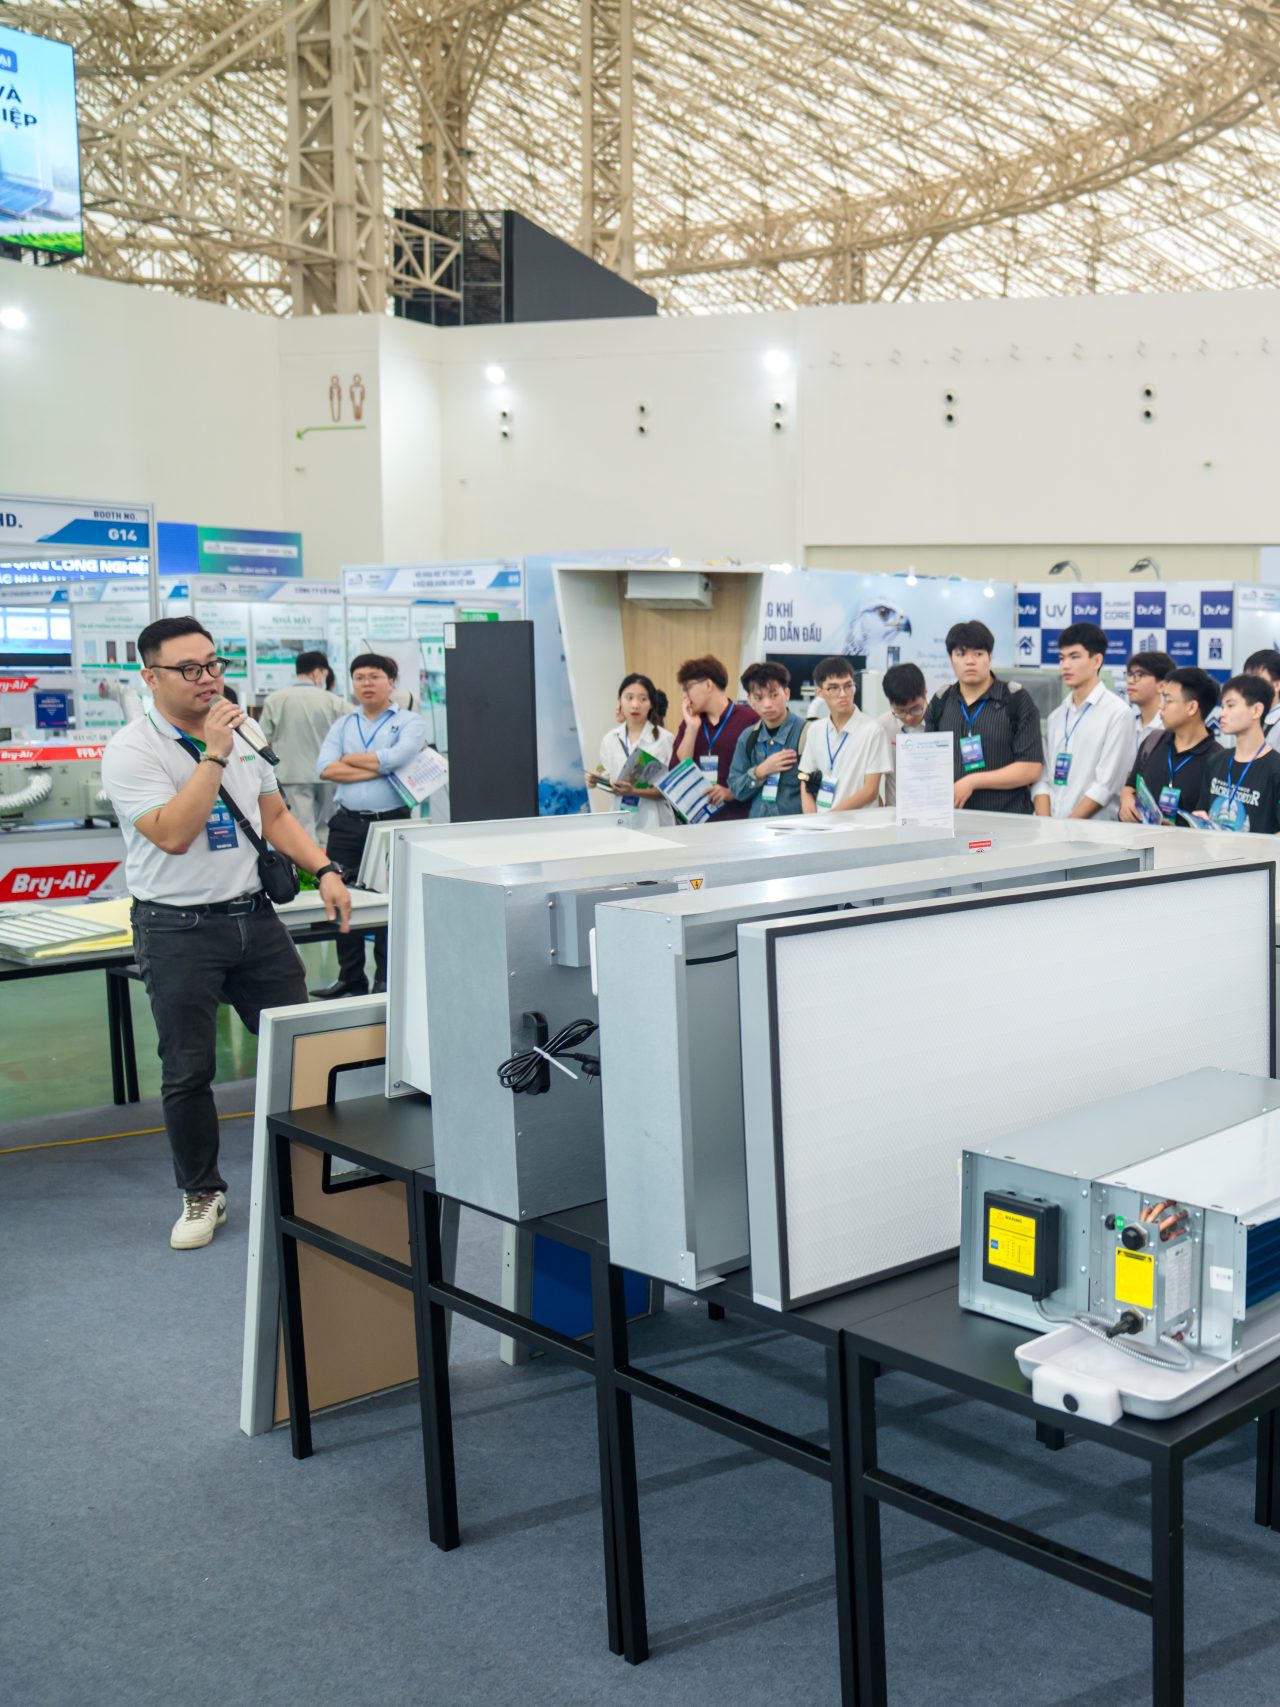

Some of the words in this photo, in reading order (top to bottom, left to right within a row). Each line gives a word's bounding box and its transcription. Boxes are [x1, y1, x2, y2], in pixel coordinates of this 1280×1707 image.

[94, 511, 121, 520] BOOTH
[108, 528, 138, 541] G14
[776, 600, 794, 617] KHÍ
[1045, 604, 1066, 618] UV
[11, 869, 96, 898] Bry-Air
